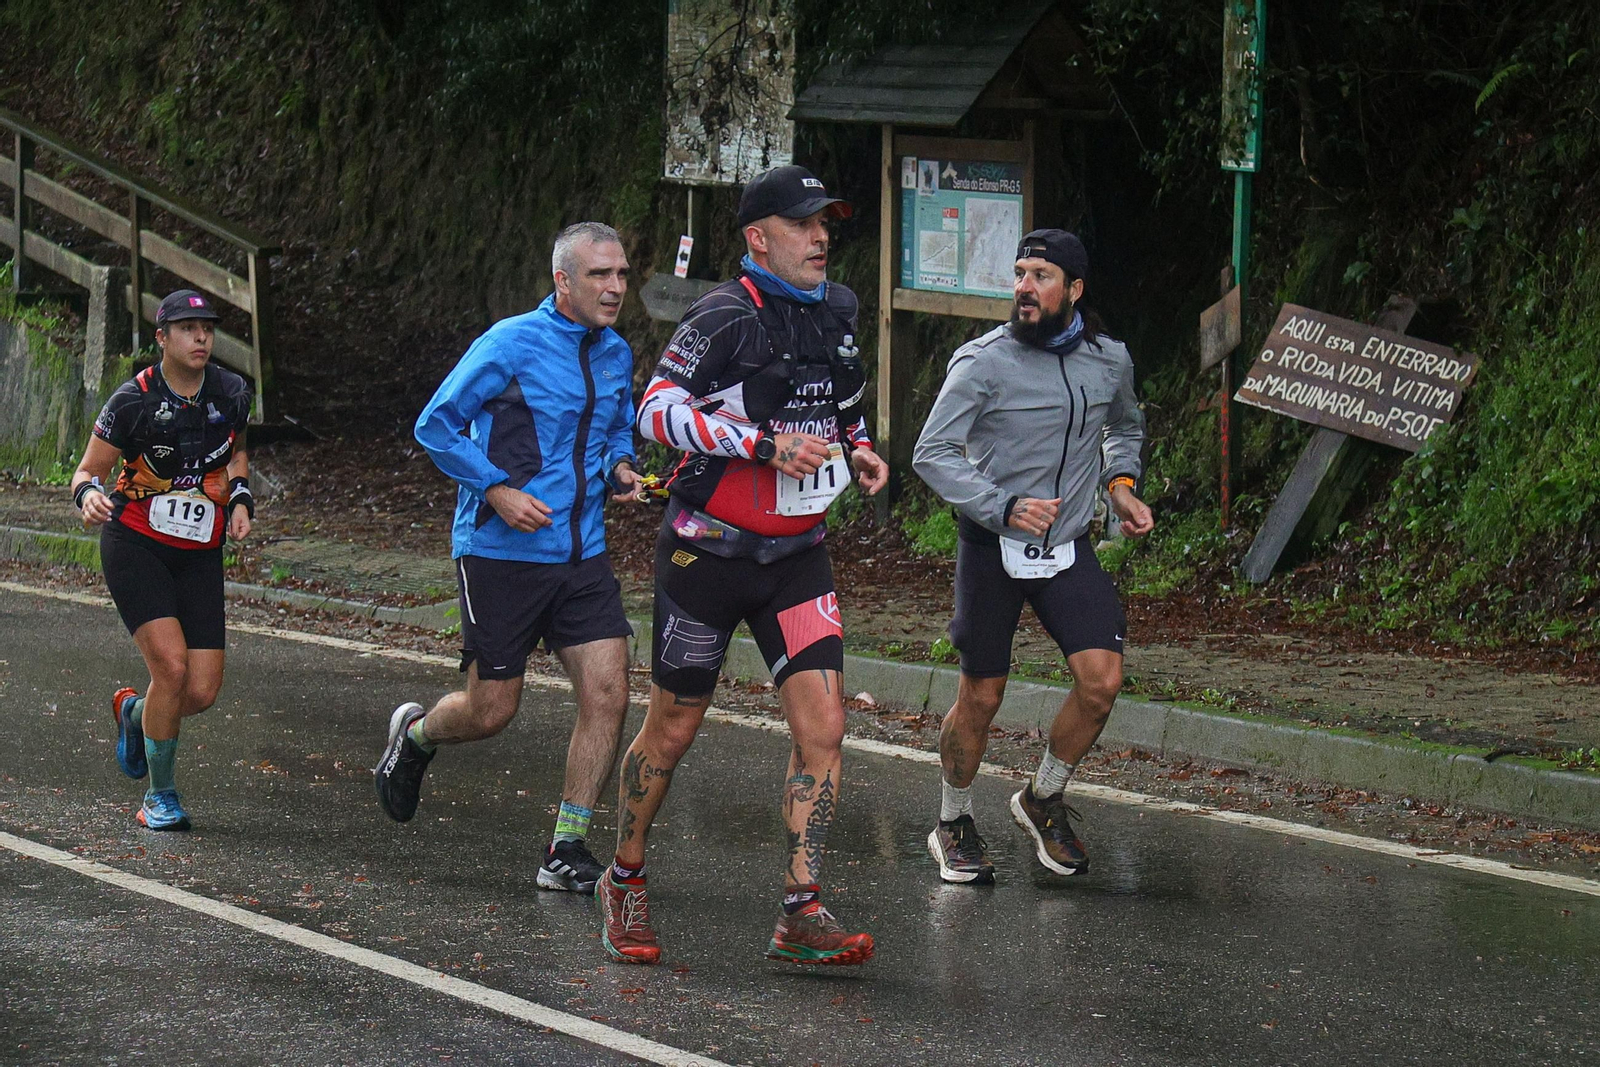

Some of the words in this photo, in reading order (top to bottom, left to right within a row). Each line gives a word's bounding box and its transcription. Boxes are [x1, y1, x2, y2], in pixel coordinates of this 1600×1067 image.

[952, 177, 970, 189] Senda
[970, 178, 978, 190] do
[1280, 315, 1326, 344] AQUI
[1325, 335, 1355, 354] ESTA
[1361, 336, 1472, 382] ENTERRADO
[1278, 346, 1315, 373] RIO
[1313, 361, 1335, 381] DA
[1339, 362, 1385, 396] VIDA,
[1392, 376, 1456, 412] VITIMA
[1243, 376, 1262, 394] DA
[1260, 373, 1365, 423] MAQUINARIA
[1362, 409, 1385, 426] DO
[167, 498, 206, 522] 119
[1024, 543, 1056, 560] 62
[662, 613, 676, 641] FOCUS
[383, 735, 404, 778] TERREX
